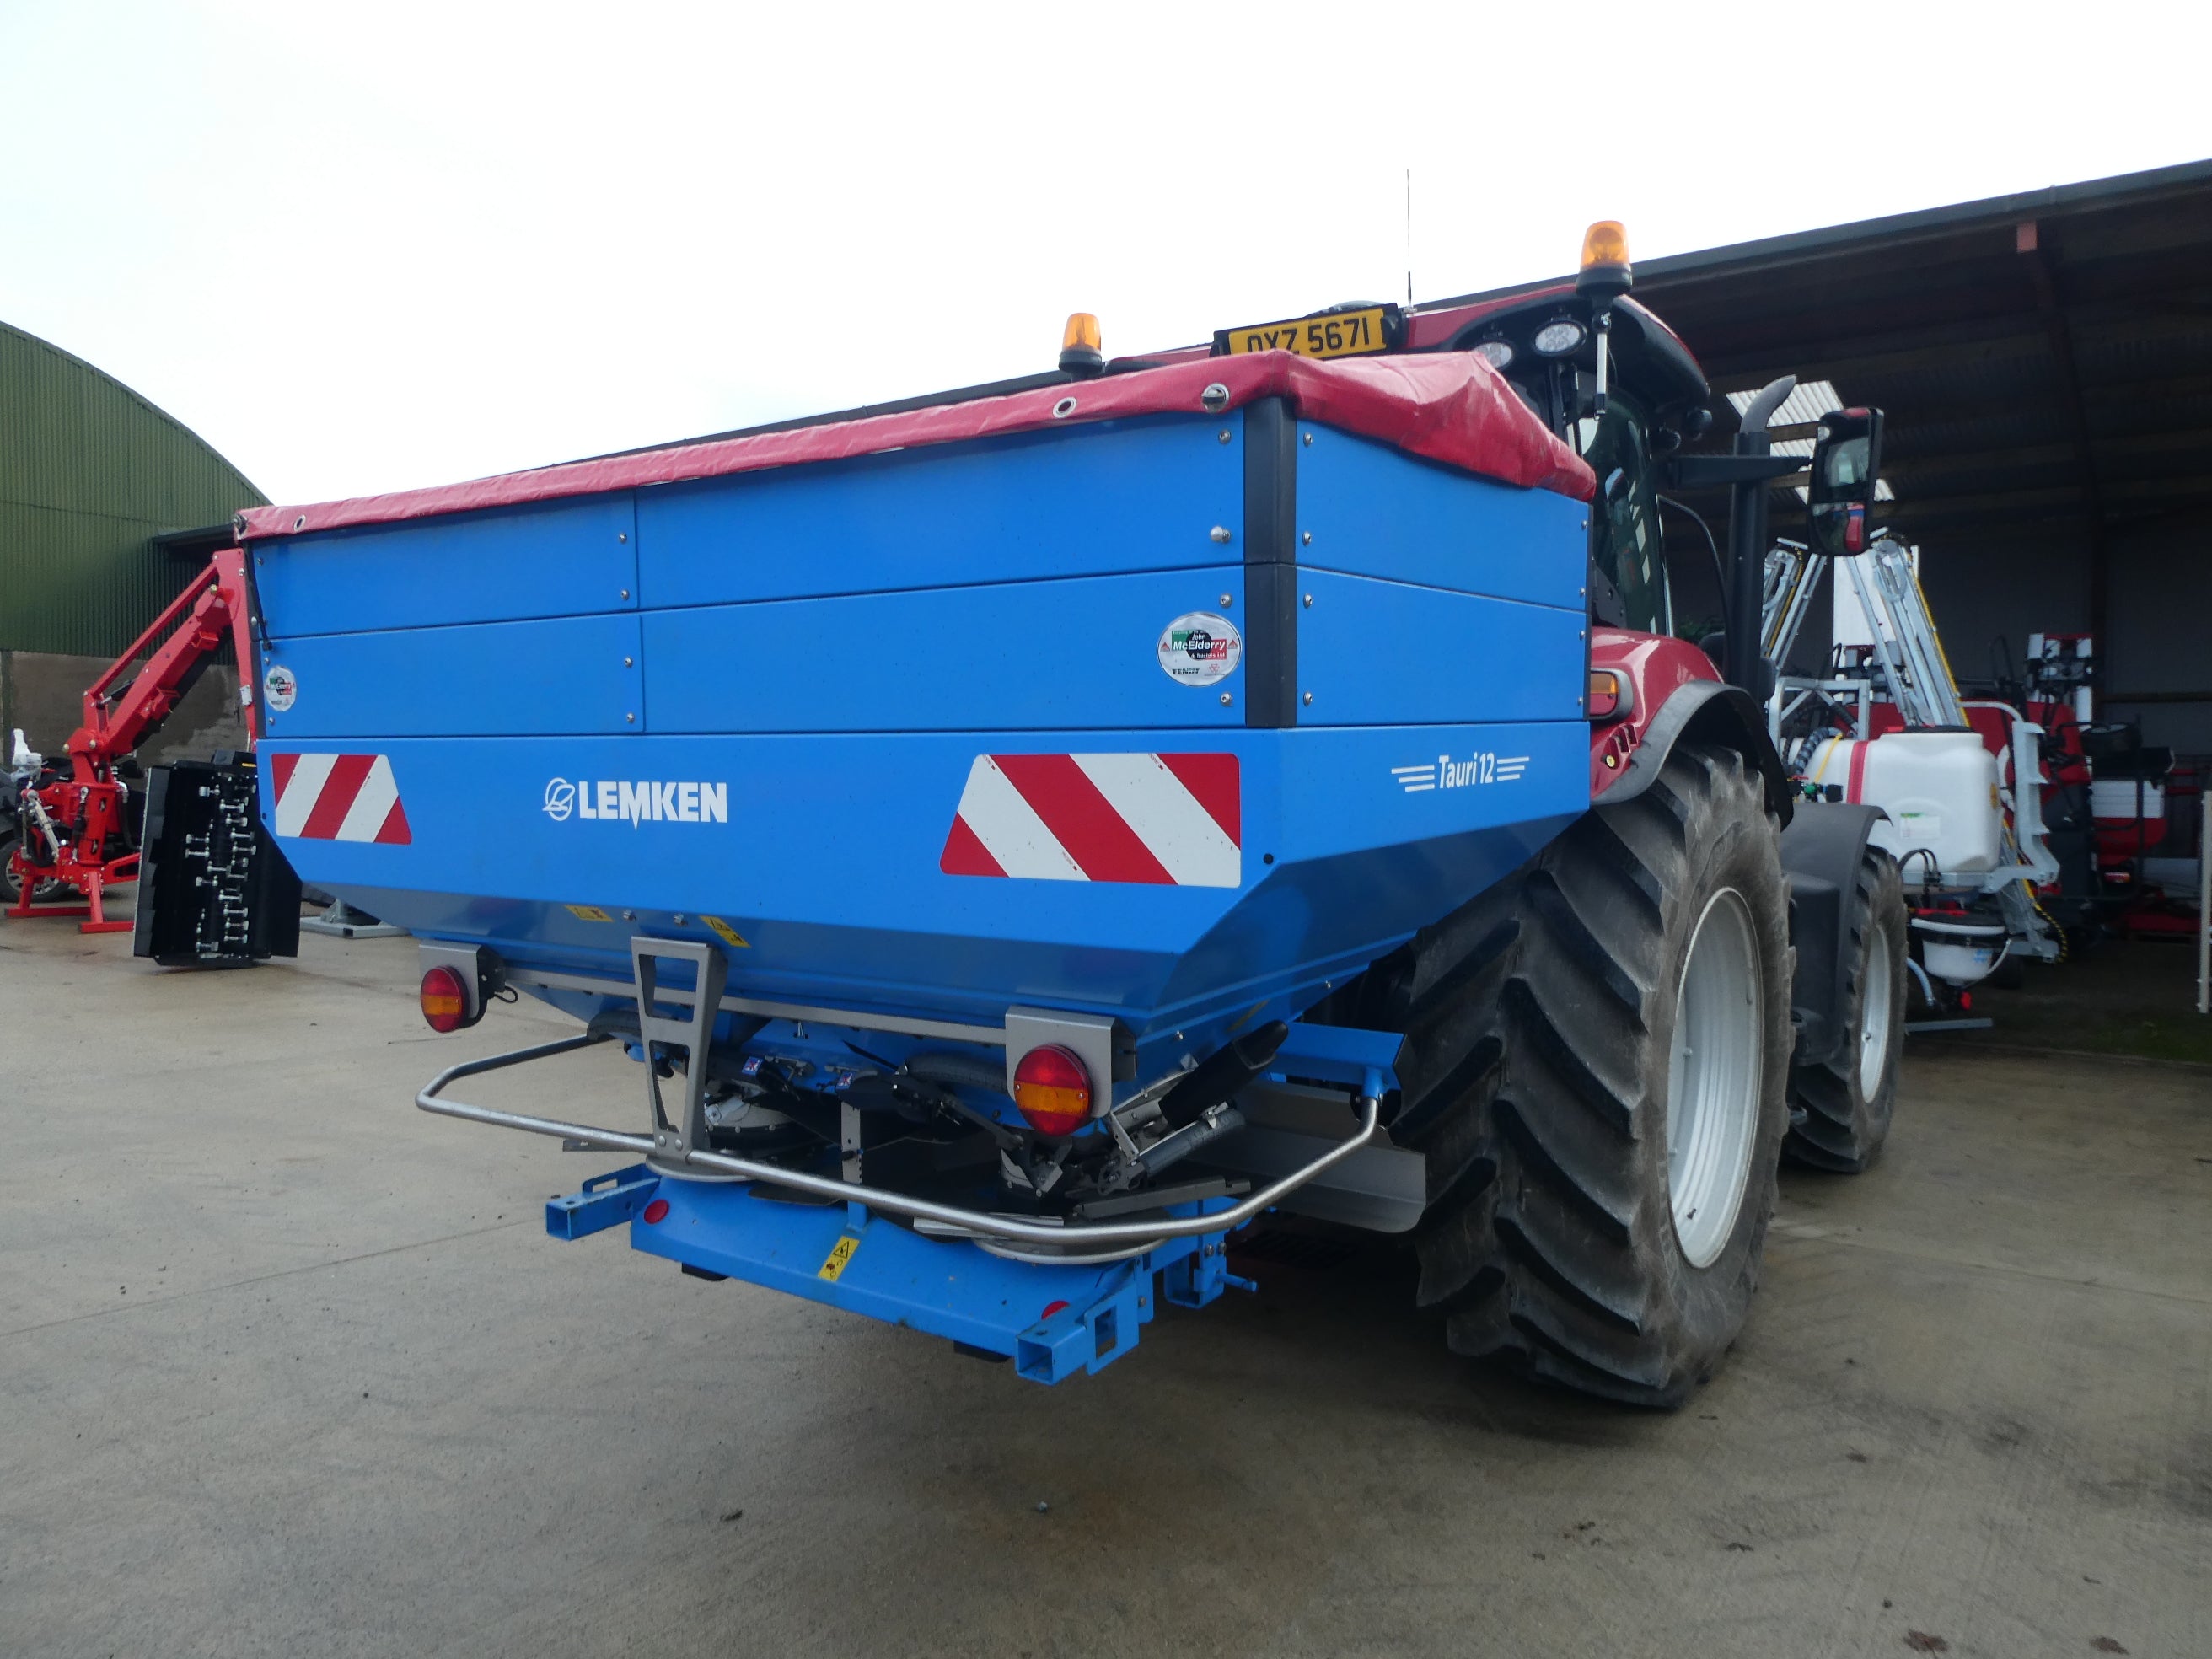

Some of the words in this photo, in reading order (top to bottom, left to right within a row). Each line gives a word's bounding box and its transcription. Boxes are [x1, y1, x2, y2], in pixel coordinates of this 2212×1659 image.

[1308, 317, 1369, 352] 5671
[1173, 640, 1226, 651] McElderry
[1438, 751, 1477, 789] Tauri
[1479, 752, 1495, 784] 12
[578, 781, 727, 830] LEMKEN
